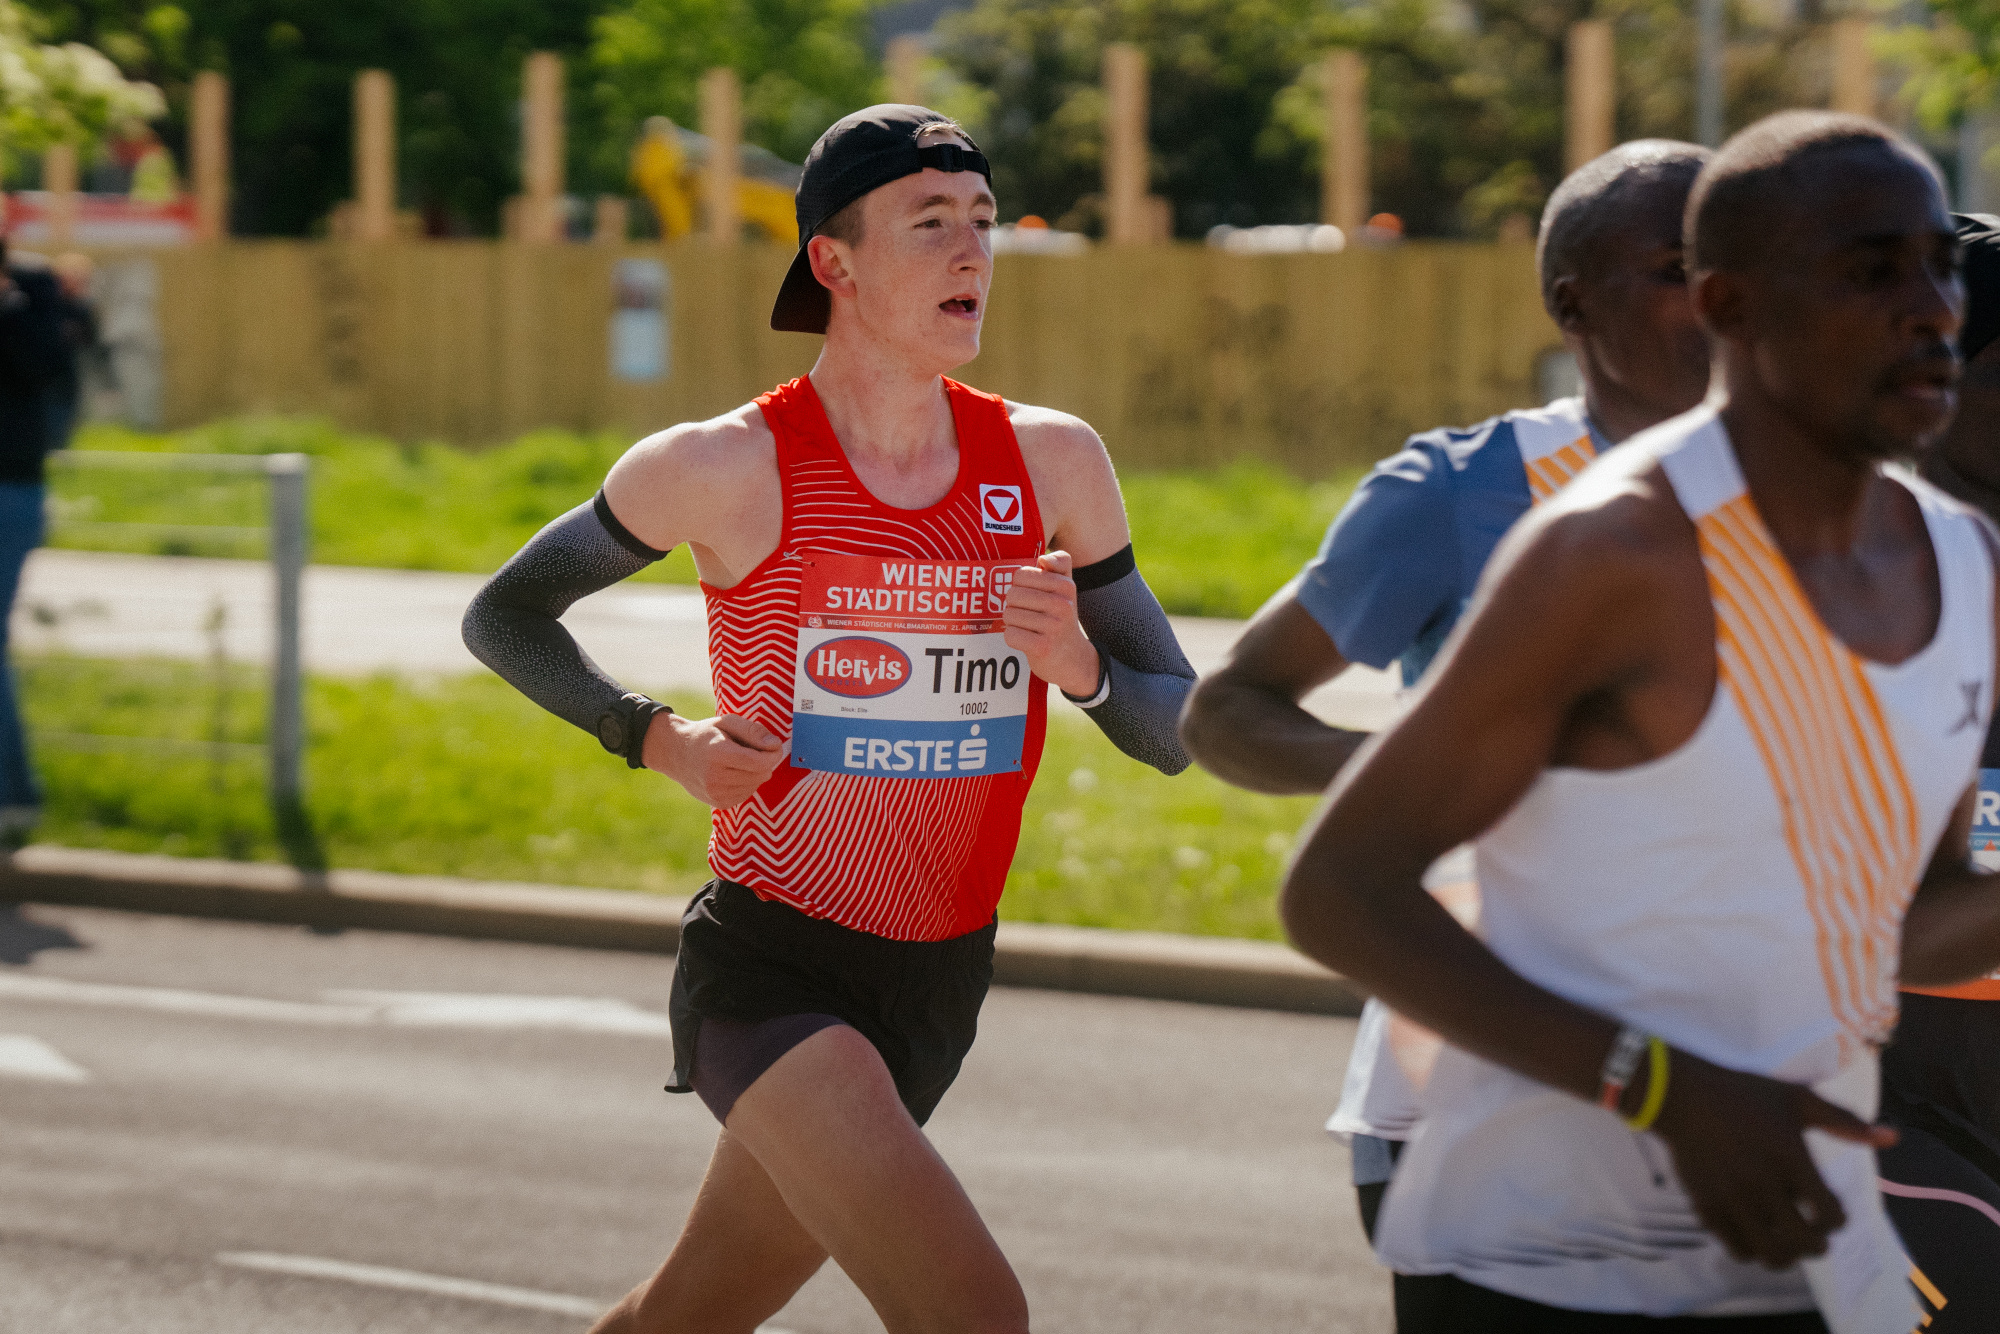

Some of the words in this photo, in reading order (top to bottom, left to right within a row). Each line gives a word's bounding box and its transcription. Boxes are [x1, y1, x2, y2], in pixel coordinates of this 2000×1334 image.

[984, 522, 1022, 532] BUNDESHEER
[881, 562, 986, 589] WIENER
[825, 586, 984, 614] STÄDTISCHE
[826, 618, 853, 627] WIENER
[853, 620, 893, 629] STÄDTISCHE
[893, 622, 947, 631] HALBMARATHON
[816, 649, 902, 686] Hervis
[925, 648, 1021, 694] Timo
[959, 701, 989, 716] 10002
[844, 736, 955, 772] ERSTE
